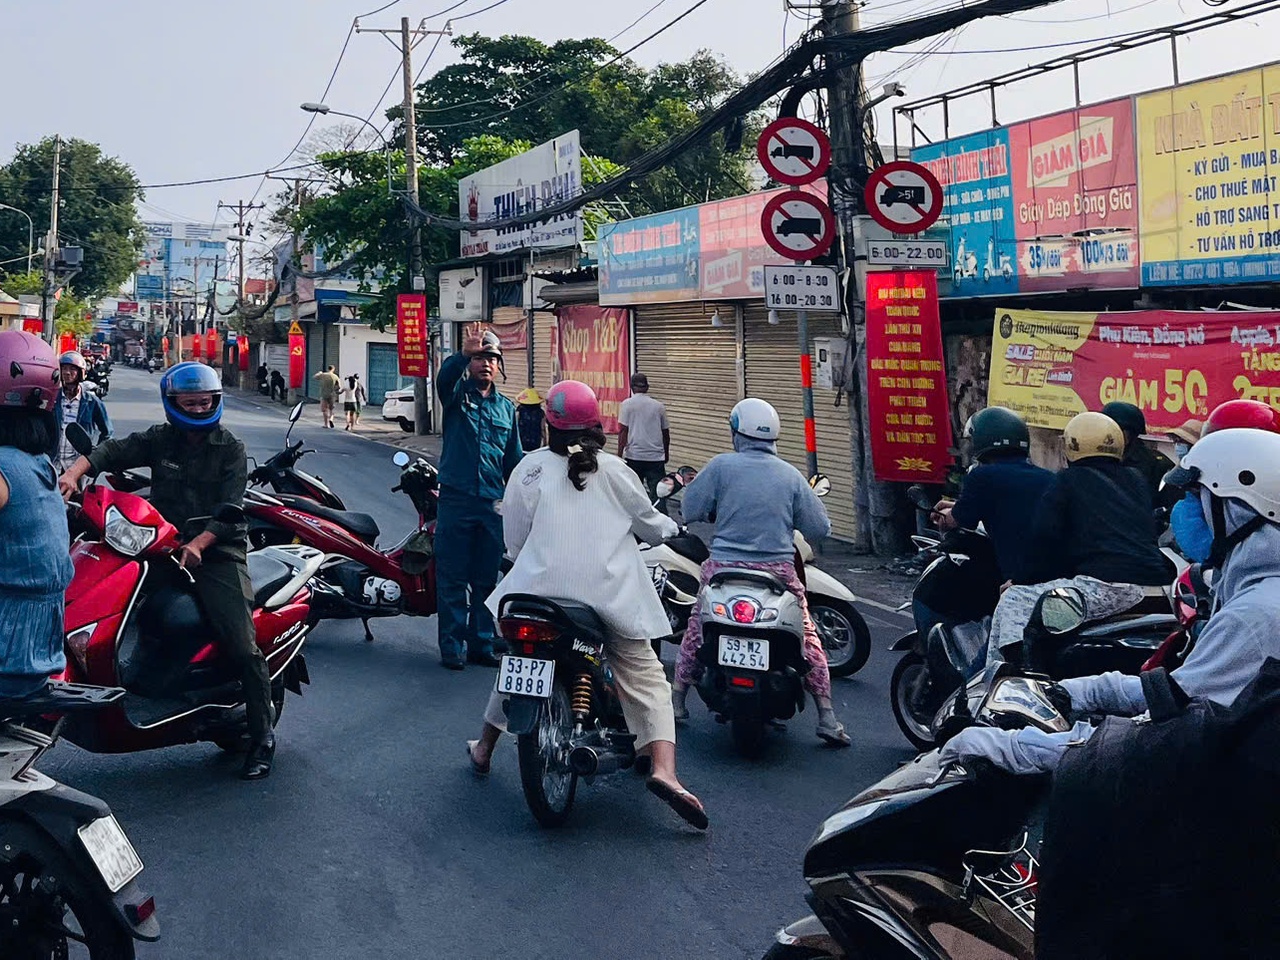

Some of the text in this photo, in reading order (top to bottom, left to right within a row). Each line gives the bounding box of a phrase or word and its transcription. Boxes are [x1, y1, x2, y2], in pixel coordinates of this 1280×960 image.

[1033, 128, 1108, 178] GIẢM GIÁ
[1195, 157, 1208, 176] KÝ
[1211, 152, 1230, 173] GỬI
[1241, 151, 1267, 169] MUA
[1195, 185, 1217, 201] CHO
[1220, 177, 1248, 198] THUÊ
[1047, 195, 1071, 220] Dép
[1109, 186, 1132, 210] Giá
[1213, 207, 1235, 227] TRỢ
[1238, 205, 1269, 223] SANG
[1197, 236, 1211, 253] TƯ
[1213, 230, 1236, 251] VẤN
[562, 317, 618, 363] Shop T&B
[1100, 369, 1158, 411] GIẢM
[572, 637, 596, 654] Wave
[505, 676, 544, 694] 8888
